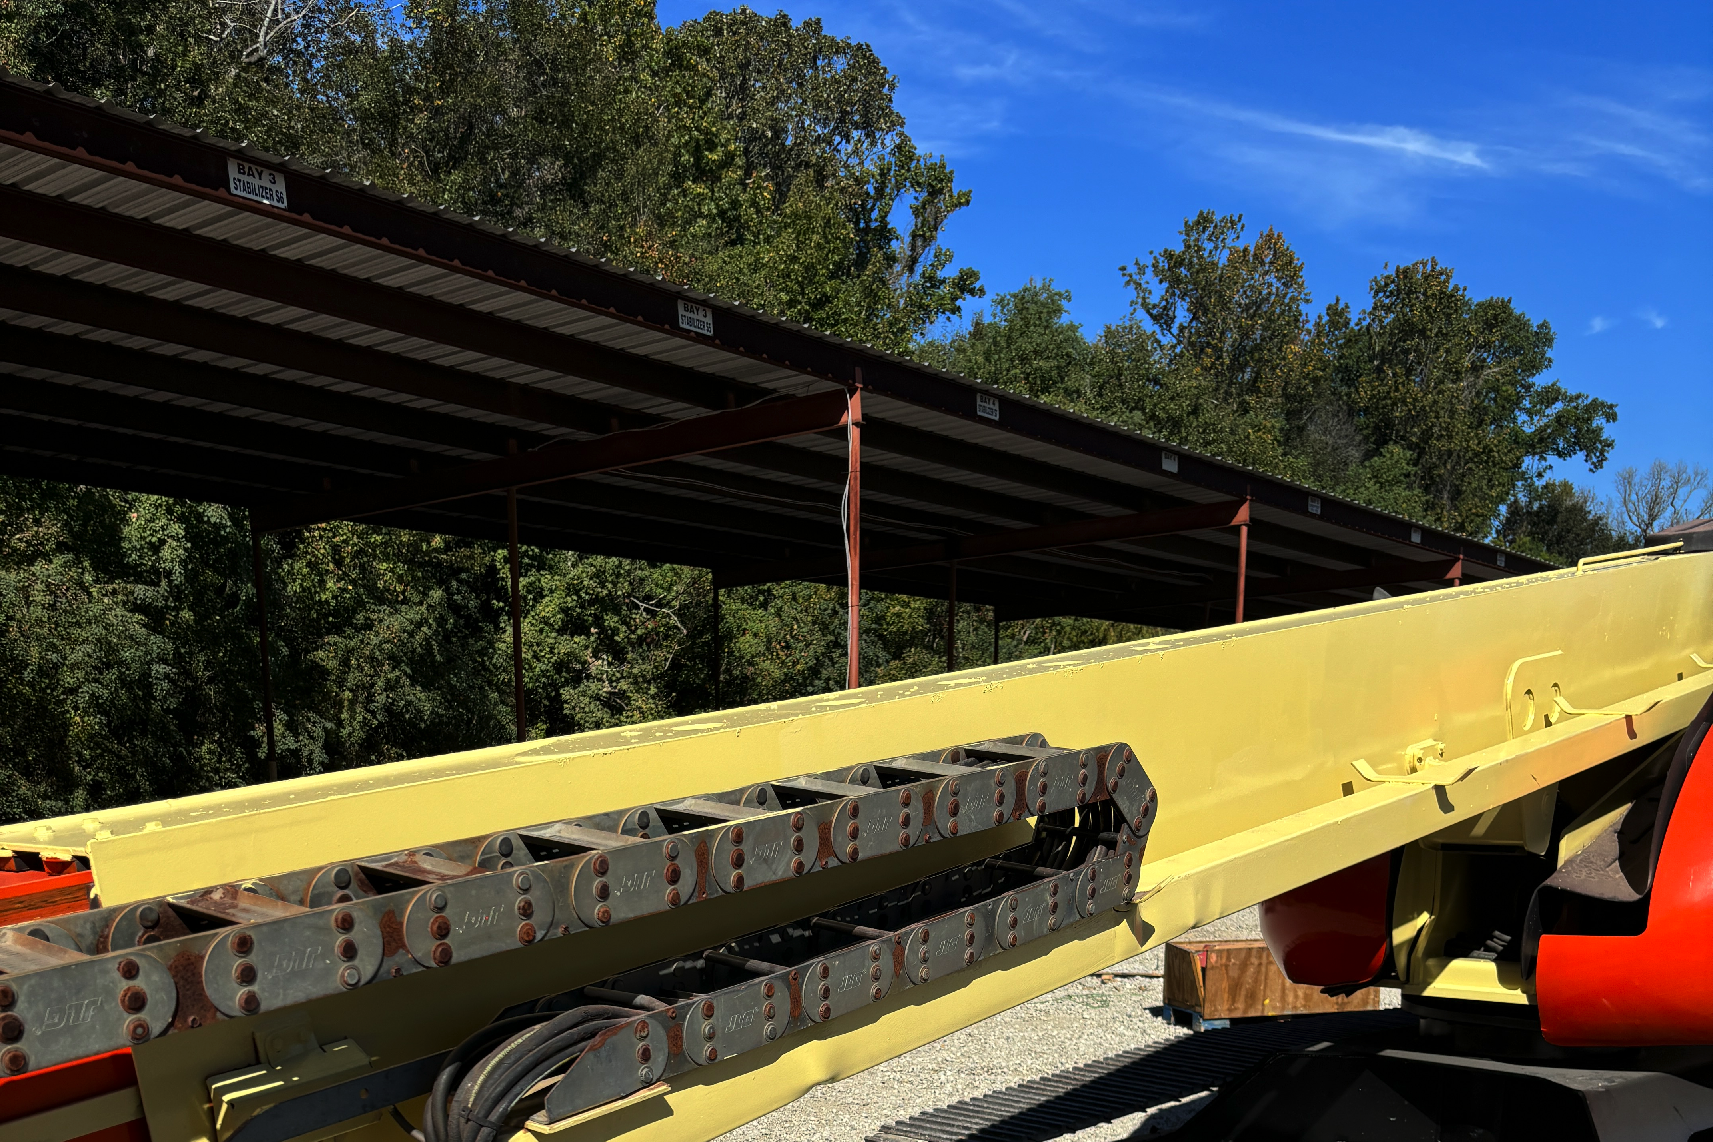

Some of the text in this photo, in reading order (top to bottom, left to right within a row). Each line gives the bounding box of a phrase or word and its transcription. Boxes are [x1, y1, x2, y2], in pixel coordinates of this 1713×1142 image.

[237, 162, 277, 185] BAY 3
[233, 177, 285, 205] STABILIZER S6
[683, 302, 708, 318] BAY 3
